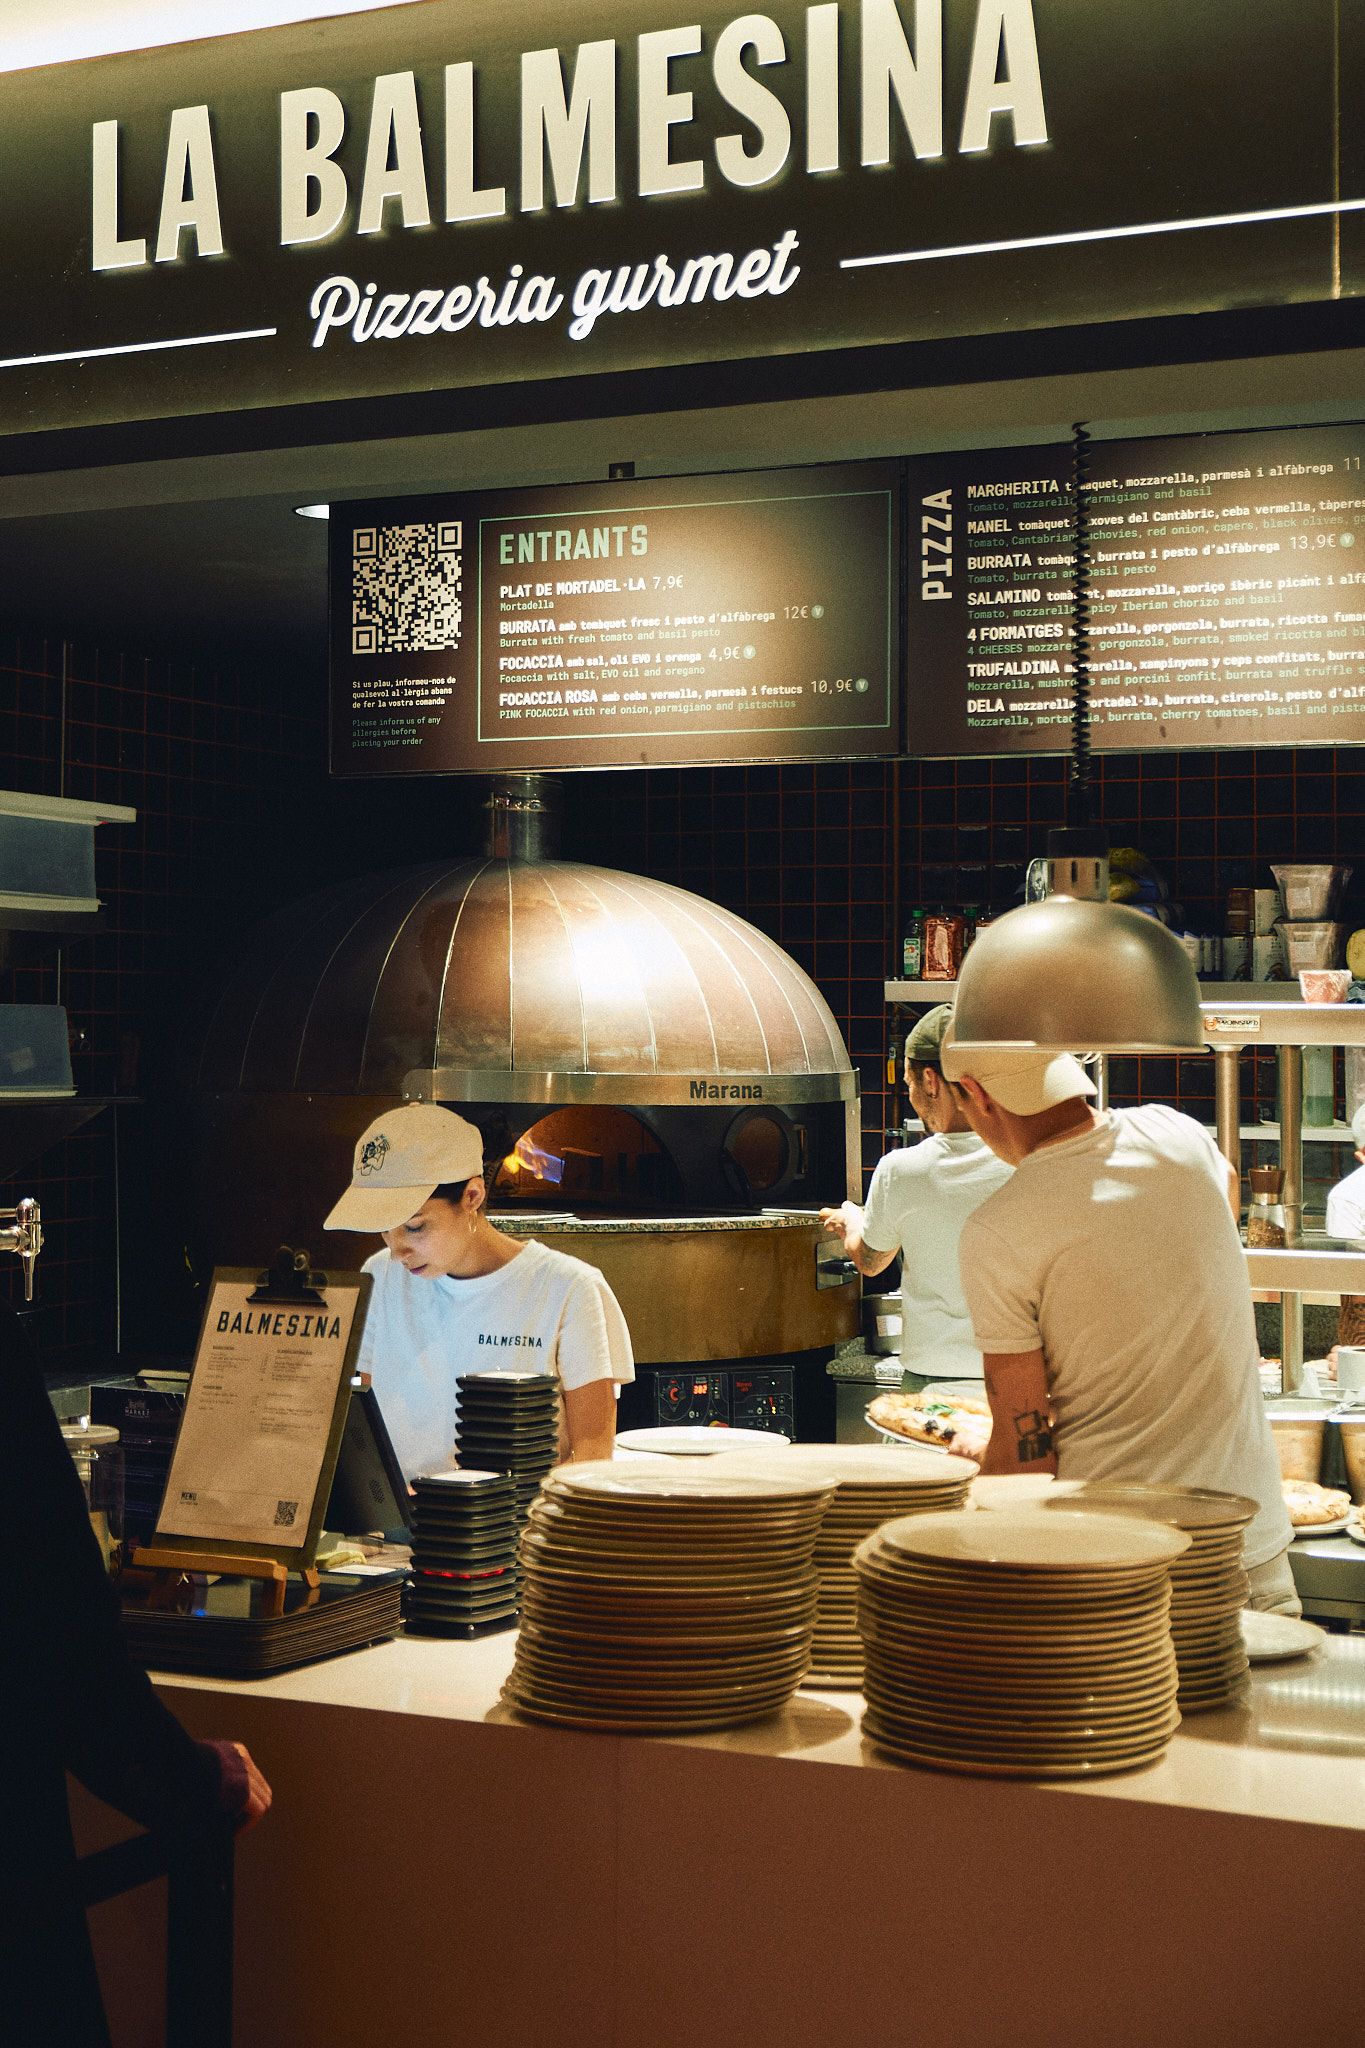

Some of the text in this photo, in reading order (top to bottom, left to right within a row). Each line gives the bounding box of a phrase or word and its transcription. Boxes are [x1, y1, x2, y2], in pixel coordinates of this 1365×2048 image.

[93, 0, 1048, 271] LA BALMESINA
[310, 229, 800, 348] Pizzeria gurmet
[968, 479, 1059, 498] MARGHERITA
[1202, 468, 1251, 484] parmesà
[1257, 467, 1264, 478] i
[1270, 464, 1333, 477] alfàbrega
[1154, 489, 1174, 499] and
[1180, 487, 1212, 497] basil
[967, 519, 1012, 534] MANEL
[1086, 515, 1124, 526] xoves
[1127, 512, 1149, 523] del
[1222, 506, 1250, 517] ceba
[1147, 527, 1167, 536] red
[500, 524, 648, 564] ENTRANTS
[922, 488, 953, 601] PIZZA
[968, 553, 1031, 570] BURRATA
[1097, 549, 1146, 562] burrata
[1151, 548, 1158, 559] i
[1163, 546, 1198, 560] pesto
[1289, 534, 1337, 550] 13,9€
[1013, 570, 1057, 581] burrata
[1124, 564, 1156, 576] pesto
[500, 584, 532, 598] PLAT
[536, 583, 552, 596] DE
[652, 575, 684, 590] 7,9€
[968, 589, 1041, 606] SALAMINO
[1277, 576, 1321, 590] picant
[1328, 575, 1334, 585] i
[500, 600, 554, 611] Mortadella
[1089, 603, 1117, 615] picy
[1122, 601, 1168, 611] Iberian
[1174, 598, 1219, 608] chorizo
[1224, 596, 1245, 606] and
[500, 619, 556, 634] BURRATA
[559, 620, 577, 631] amb
[783, 605, 808, 620] 12€
[967, 628, 977, 641] 4
[980, 624, 1064, 641] FORMATGES
[1277, 613, 1328, 625] ricotta
[500, 630, 654, 647] Burrata with fresh tomato and
[979, 644, 1022, 655] CHEESES
[1229, 632, 1269, 642] smoked
[500, 654, 564, 670] FOCACCIA
[566, 656, 584, 667] amb
[610, 654, 628, 665] oli
[709, 645, 741, 661] 4,9€
[967, 660, 1060, 677] TRUFALDINA
[1223, 656, 1251, 667] ceps
[352, 681, 361, 689] Si
[447, 676, 456, 684] de
[500, 672, 542, 683] Focaccia
[547, 671, 569, 681] with
[601, 669, 618, 678] EVO
[623, 668, 639, 677] oil
[644, 667, 660, 676] and
[665, 666, 705, 676] oregano
[1101, 675, 1120, 685] and
[1125, 673, 1170, 686] porcini
[1226, 669, 1273, 679] burrata
[1305, 666, 1352, 676] truffle
[352, 689, 389, 699] qualsevol
[499, 691, 563, 706] FOCACCIA
[565, 689, 598, 703] ROSA
[602, 691, 620, 702] amb
[751, 685, 757, 696] i
[761, 684, 802, 695] festucs
[811, 678, 853, 694] 10,9€
[967, 699, 1005, 713] DELA
[1088, 695, 1163, 708] ortadel·la,
[1285, 689, 1322, 702] pesto
[363, 700, 375, 708] fer
[378, 699, 386, 707] la
[388, 698, 413, 706] vostra
[415, 697, 445, 705] comanda
[500, 709, 522, 718] PINK
[525, 707, 569, 718] FOCACCIA
[573, 706, 595, 716] with
[600, 705, 616, 715] red
[655, 702, 711, 715] parmigiano
[716, 701, 733, 710] and
[737, 699, 796, 711] pistachios
[1162, 710, 1200, 720] cherry
[1267, 705, 1300, 715] basil
[1307, 704, 1327, 713] and
[379, 718, 404, 726] inform
[427, 717, 441, 725] any
[391, 727, 416, 735] before
[352, 737, 423, 748] placing your order
[689, 1080, 763, 1099] Marana
[216, 1310, 340, 1339] BALMESINA
[478, 1333, 542, 1348] BALMESINA
